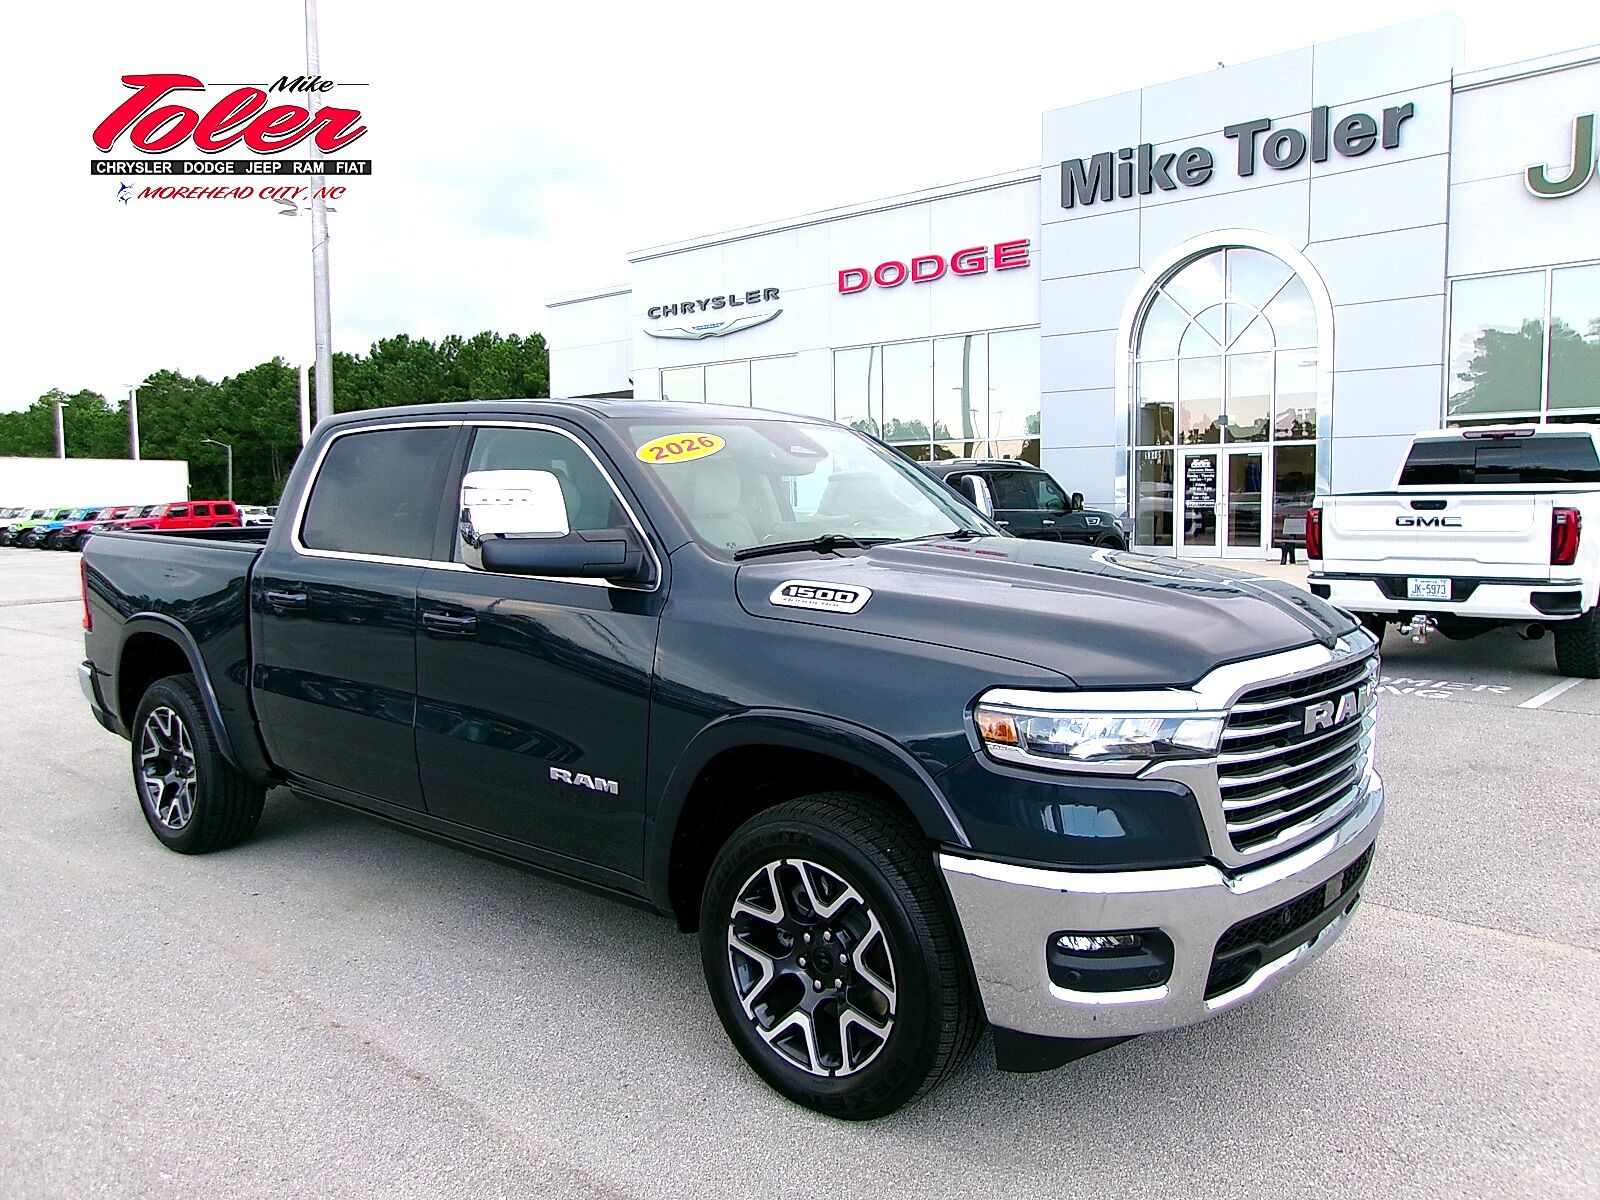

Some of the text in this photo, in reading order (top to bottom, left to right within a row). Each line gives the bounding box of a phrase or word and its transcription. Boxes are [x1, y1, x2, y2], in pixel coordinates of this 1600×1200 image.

[1060, 102, 1414, 209] Mike Toler
[1523, 111, 1600, 200] J
[838, 238, 1031, 295] DODGE
[647, 287, 781, 320] CHRYSLER
[649, 435, 715, 460] 2026
[1395, 515, 1463, 527] GMC
[788, 586, 855, 603] 1500
[1411, 583, 1446, 595] JK-5973
[549, 766, 619, 795] RAM
